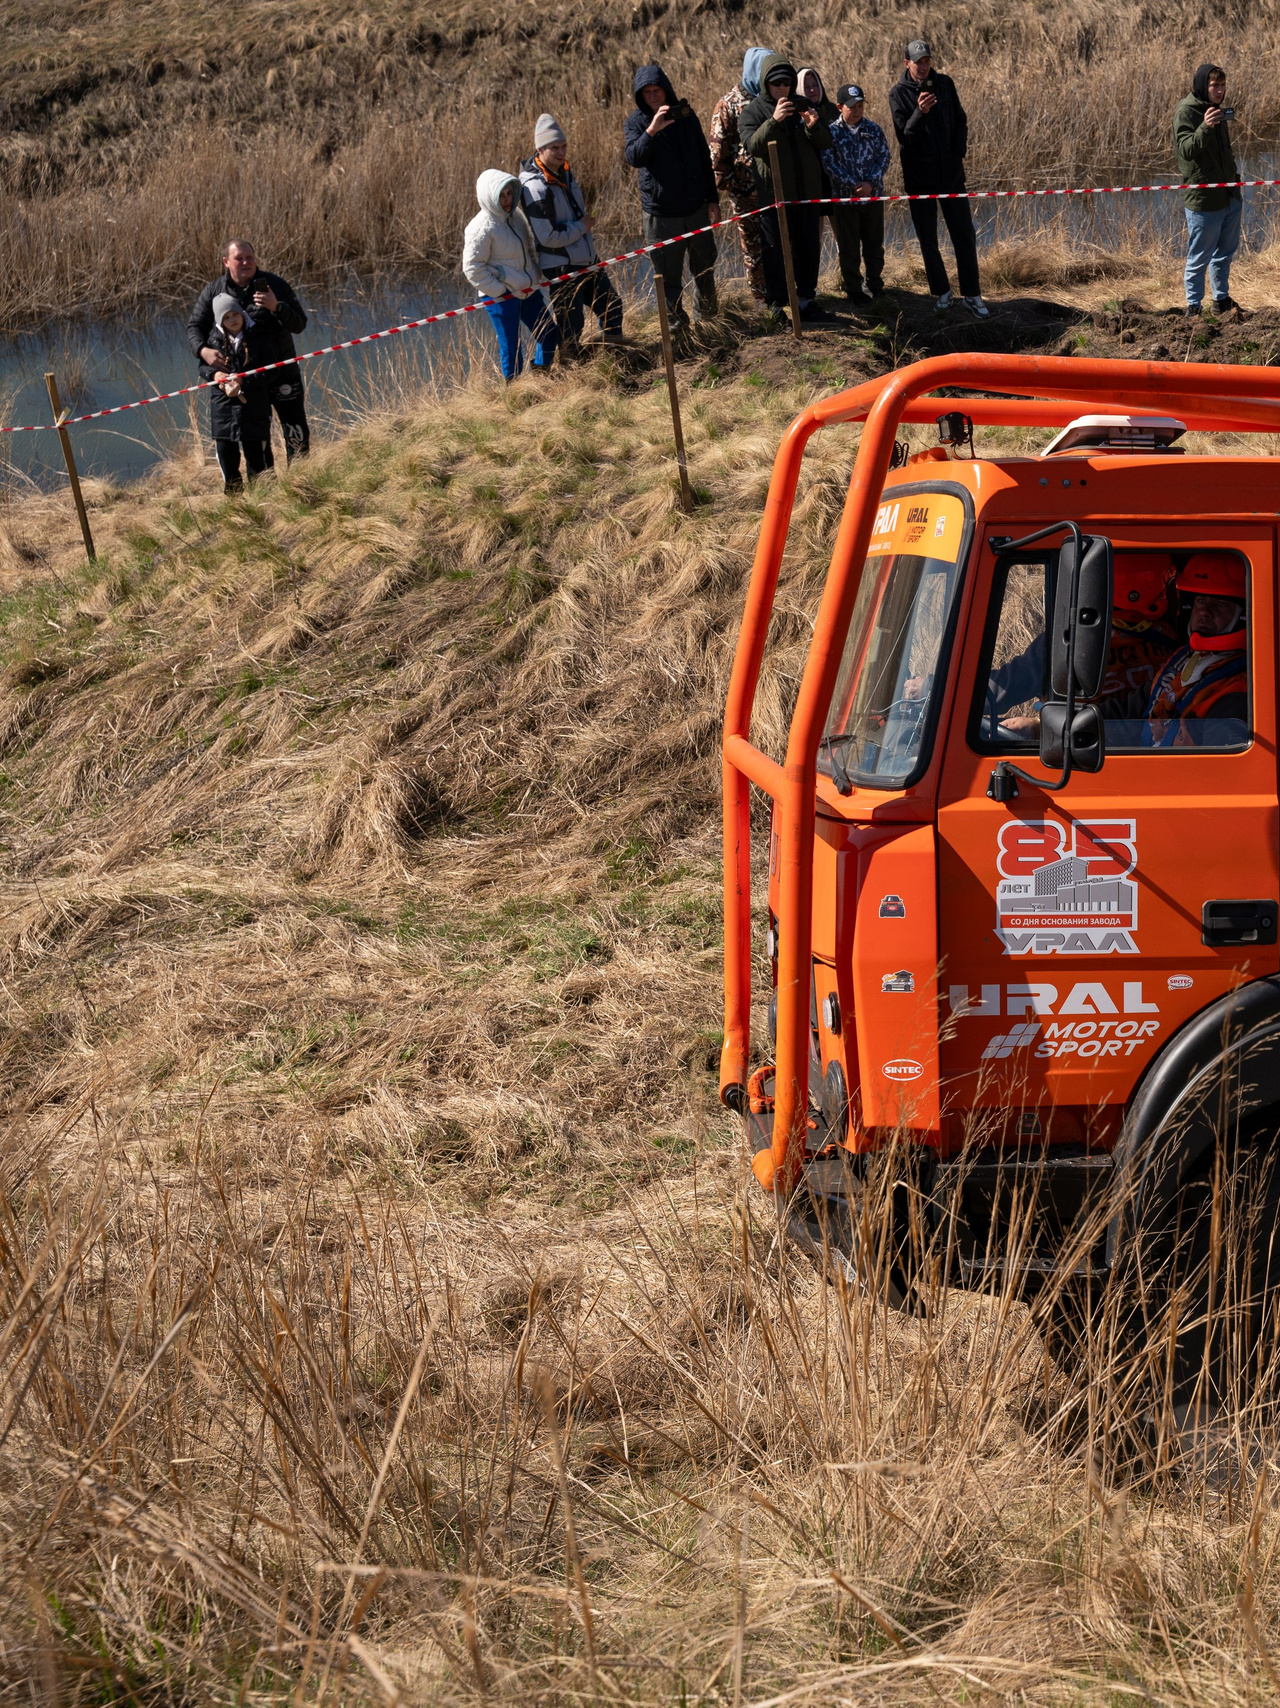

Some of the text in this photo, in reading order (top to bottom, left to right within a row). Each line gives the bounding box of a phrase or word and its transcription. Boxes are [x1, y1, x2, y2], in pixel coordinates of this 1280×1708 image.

[906, 507, 929, 523] URAL
[997, 819, 1138, 877] 85
[1000, 883, 1031, 893] лет
[1010, 917, 1121, 927] СО ДНЯ ОСНОВАНИЯ ЗАВОДА
[998, 931, 1136, 952] УРАЛ
[949, 982, 1160, 1016] URAL
[1043, 1020, 1160, 1038] MOTOR
[1034, 1040, 1145, 1058] SPORT
[884, 1065, 922, 1075] SINTEC
